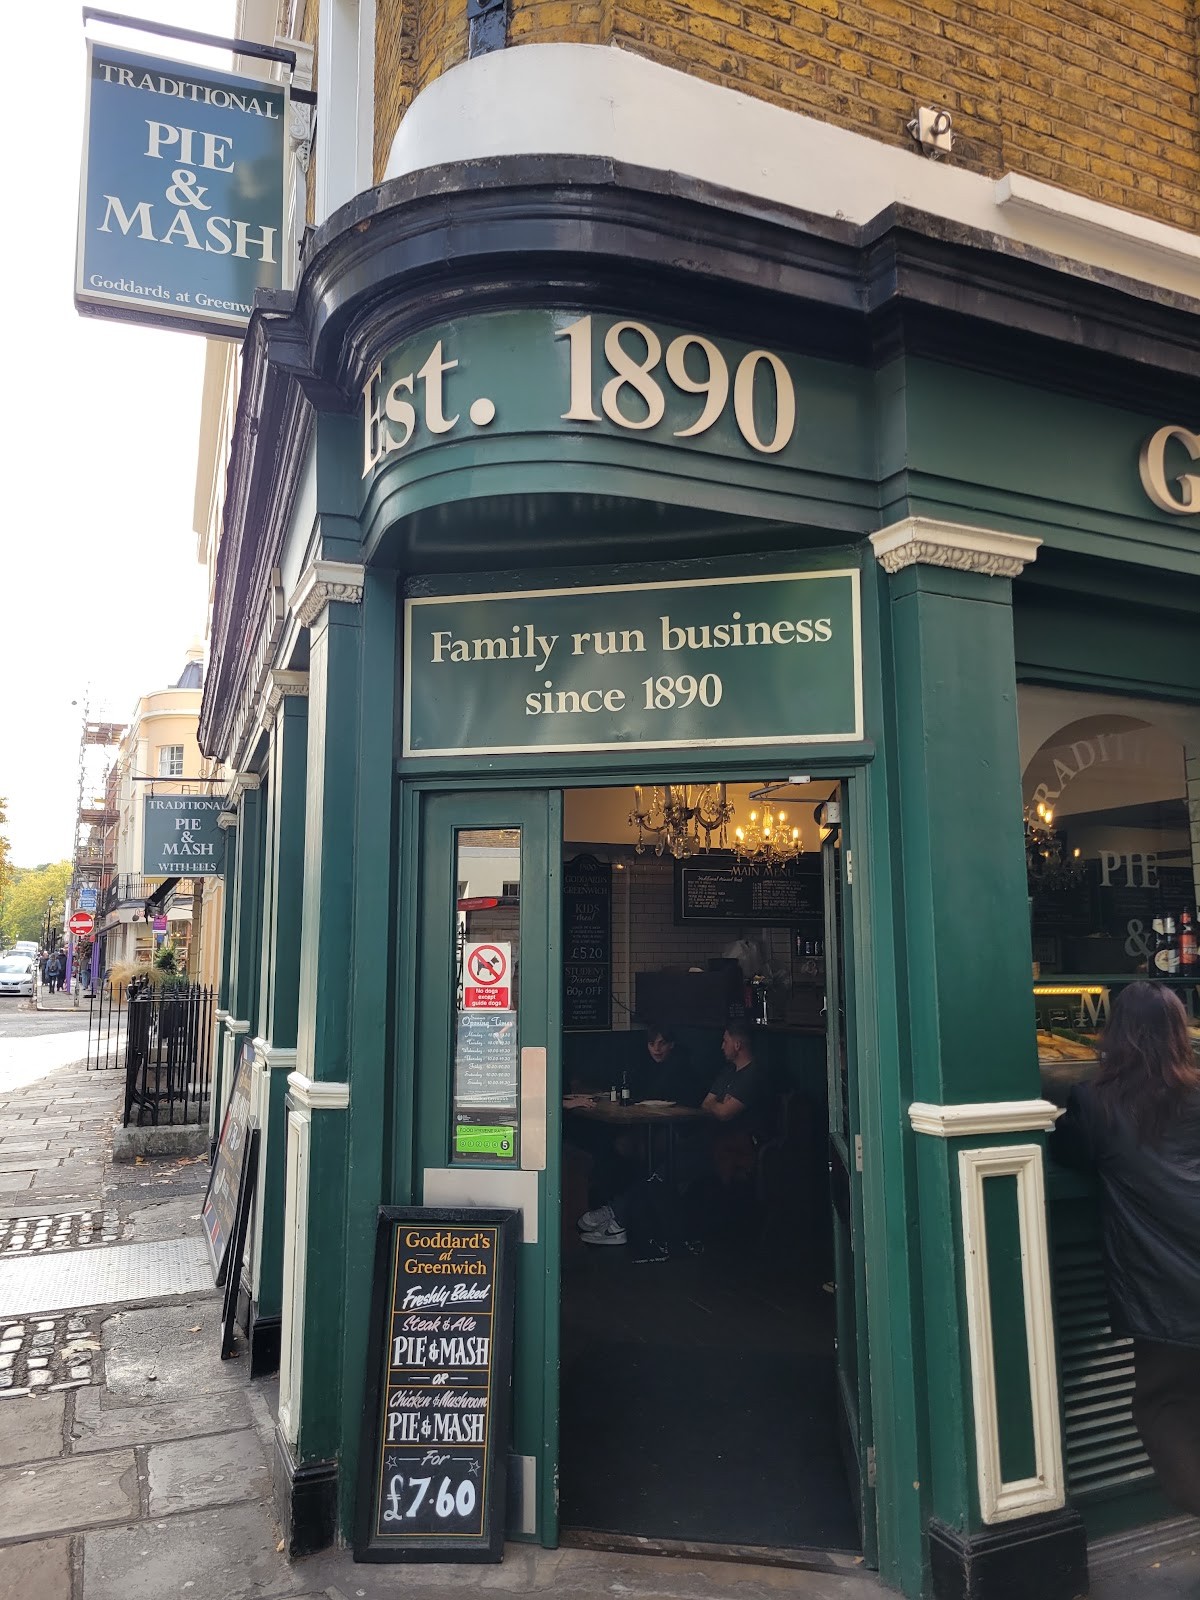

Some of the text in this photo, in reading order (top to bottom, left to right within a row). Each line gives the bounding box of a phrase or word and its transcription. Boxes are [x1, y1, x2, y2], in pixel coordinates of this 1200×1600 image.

[99, 63, 279, 119] TRADITIONAL
[144, 119, 235, 173] PIE
[165, 169, 212, 211] &
[96, 194, 278, 264] MASH
[89, 274, 170, 300] Goddards
[175, 289, 190, 303] at
[360, 315, 796, 480] Est. 1890
[431, 612, 833, 672] Family run business
[525, 673, 723, 716] since 1890
[175, 818, 201, 830] PIE
[181, 831, 195, 843] &
[162, 843, 214, 855] MASH
[731, 866, 795, 878] MAIN MENU
[1098, 850, 1160, 888] PIE
[576, 904, 601, 914] KIDS
[1124, 918, 1153, 957] &
[565, 966, 606, 976] STUDENT
[462, 1016, 490, 1028] Opening
[502, 1141, 508, 1149] 5
[405, 1231, 491, 1249] Goddard's
[438, 1249, 453, 1261] at
[404, 1259, 487, 1275] Greenwich
[402, 1282, 491, 1310] Freshly Baked
[402, 1315, 477, 1333] Steak & Ale
[392, 1335, 490, 1367] PIE & MASH
[432, 1373, 450, 1385] OR
[389, 1390, 432, 1409] Chicken
[438, 1390, 488, 1409] Mushroom
[387, 1412, 485, 1443] PIE & MASH
[421, 1450, 450, 1466] For
